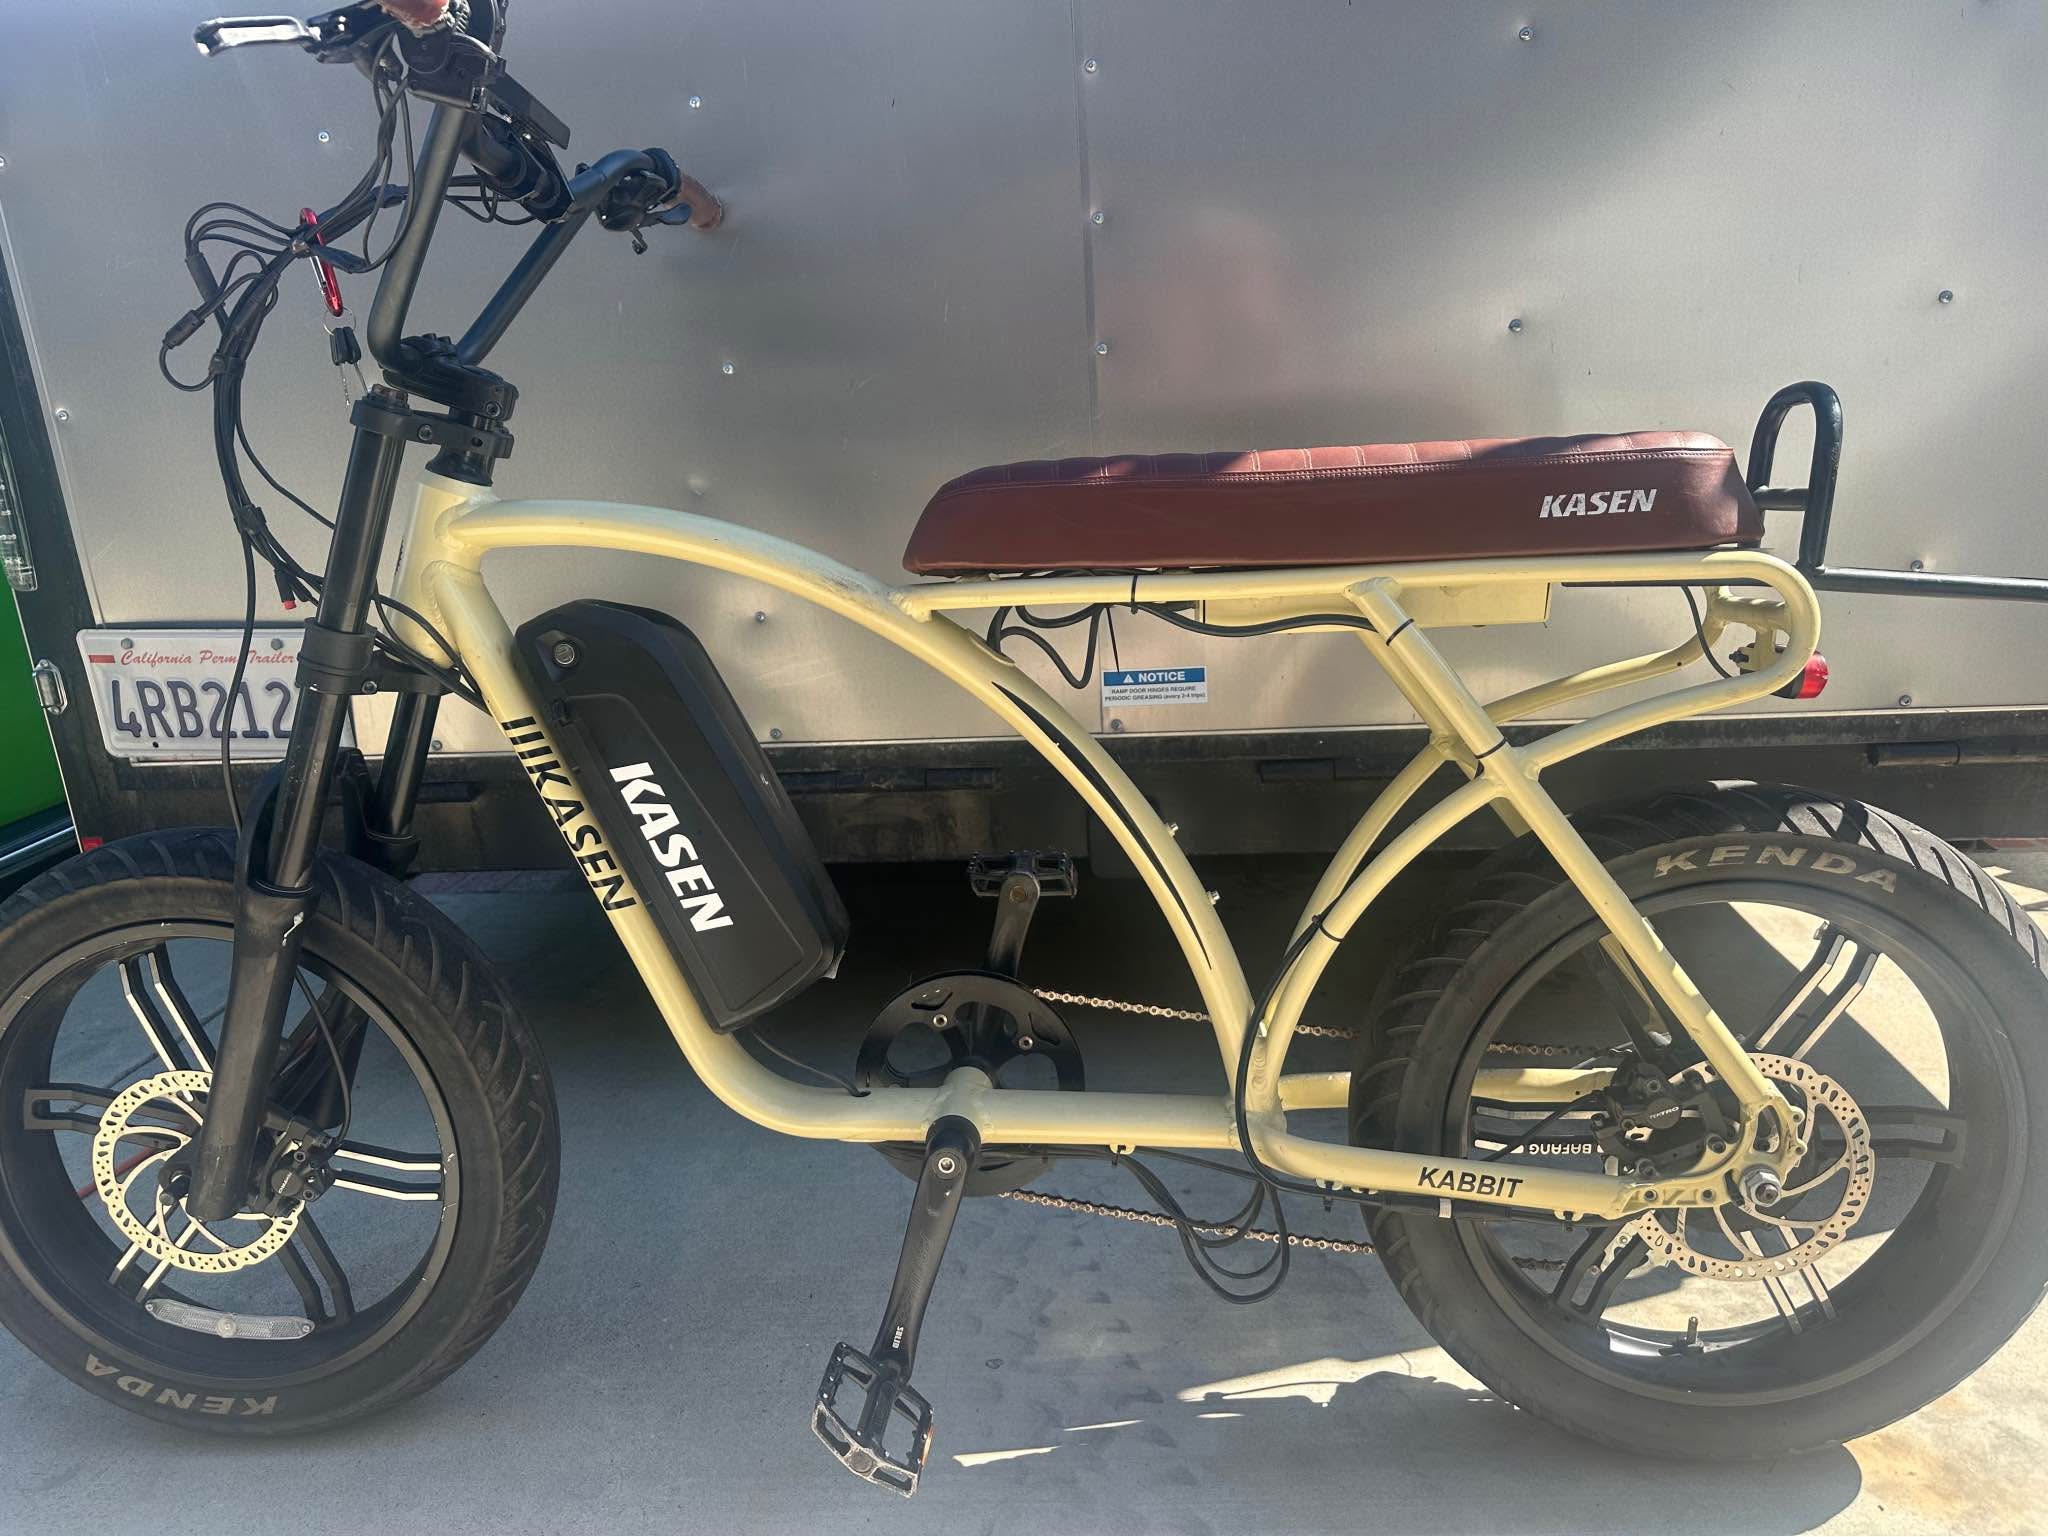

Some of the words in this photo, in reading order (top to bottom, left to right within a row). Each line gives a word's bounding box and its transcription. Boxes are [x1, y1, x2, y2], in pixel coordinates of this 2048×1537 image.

[1540, 488, 1657, 518] KASEN
[120, 650, 193, 668] California
[248, 649, 295, 665] Trailer
[1138, 671, 1186, 683] NOTICE
[111, 680, 293, 739] 4RB212
[527, 759, 636, 912] KASEN
[609, 761, 734, 932] KASEN
[1653, 845, 1897, 894] KENDA
[1529, 1144, 1592, 1155] BAFANG
[1418, 1167, 1523, 1198] KABBIT
[85, 1354, 278, 1415] KENDA
